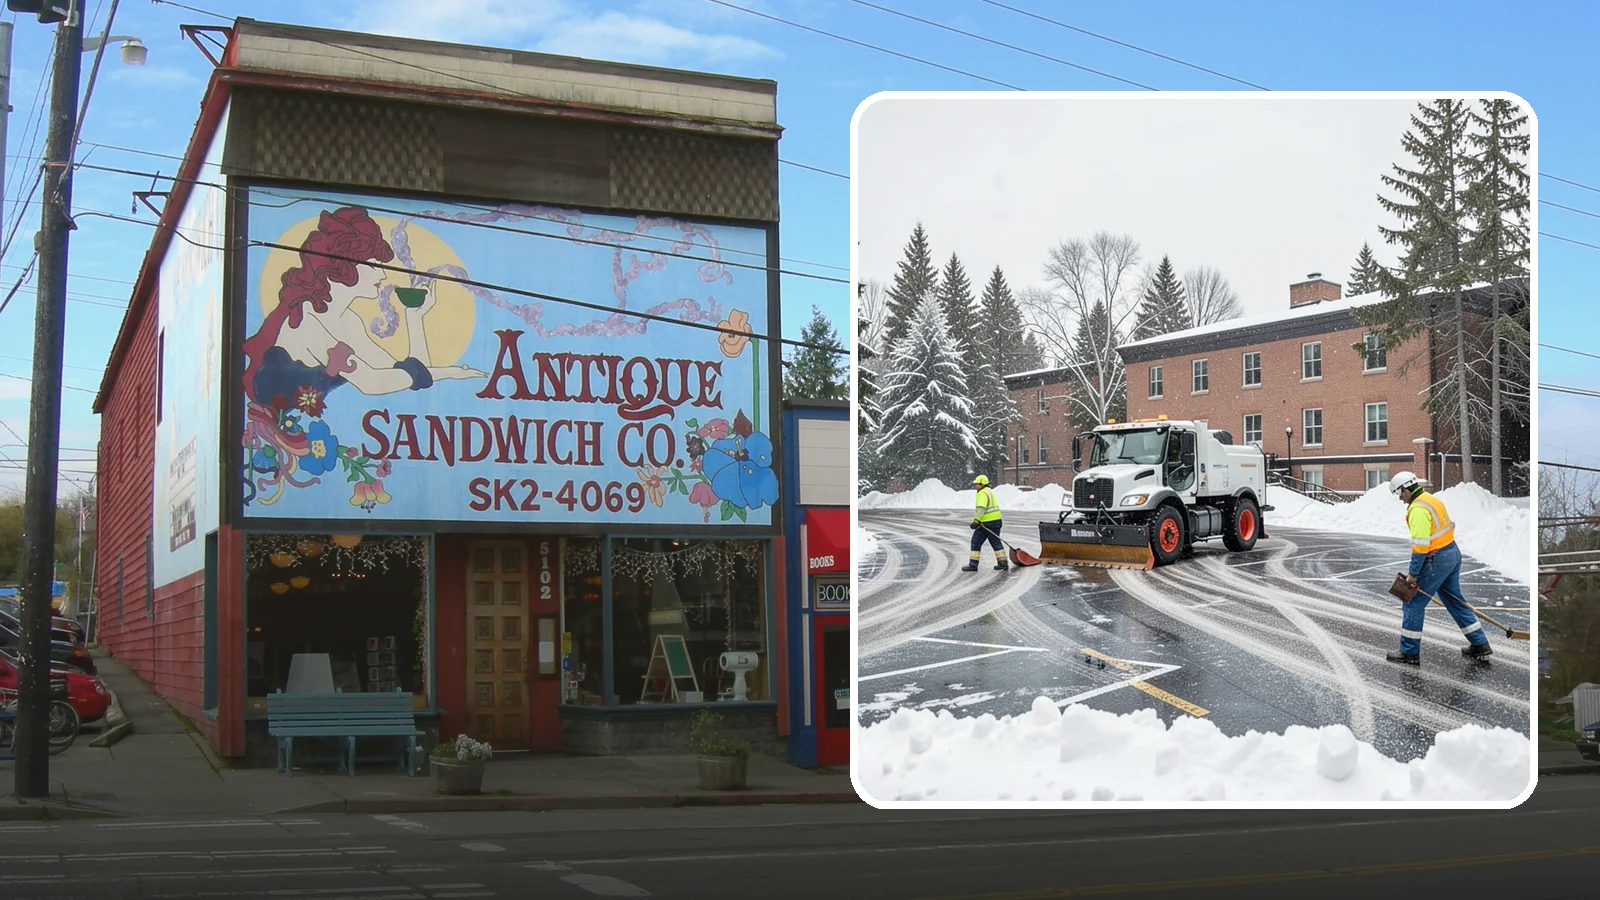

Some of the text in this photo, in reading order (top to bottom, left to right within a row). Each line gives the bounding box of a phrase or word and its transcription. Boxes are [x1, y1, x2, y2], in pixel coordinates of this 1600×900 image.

[475, 329, 723, 421] ANTIQUE
[361, 408, 685, 469] SANDWICH CO.
[468, 477, 646, 513] SK2-4069
[539, 541, 552, 600] 5102
[809, 555, 835, 569] BOOKS
